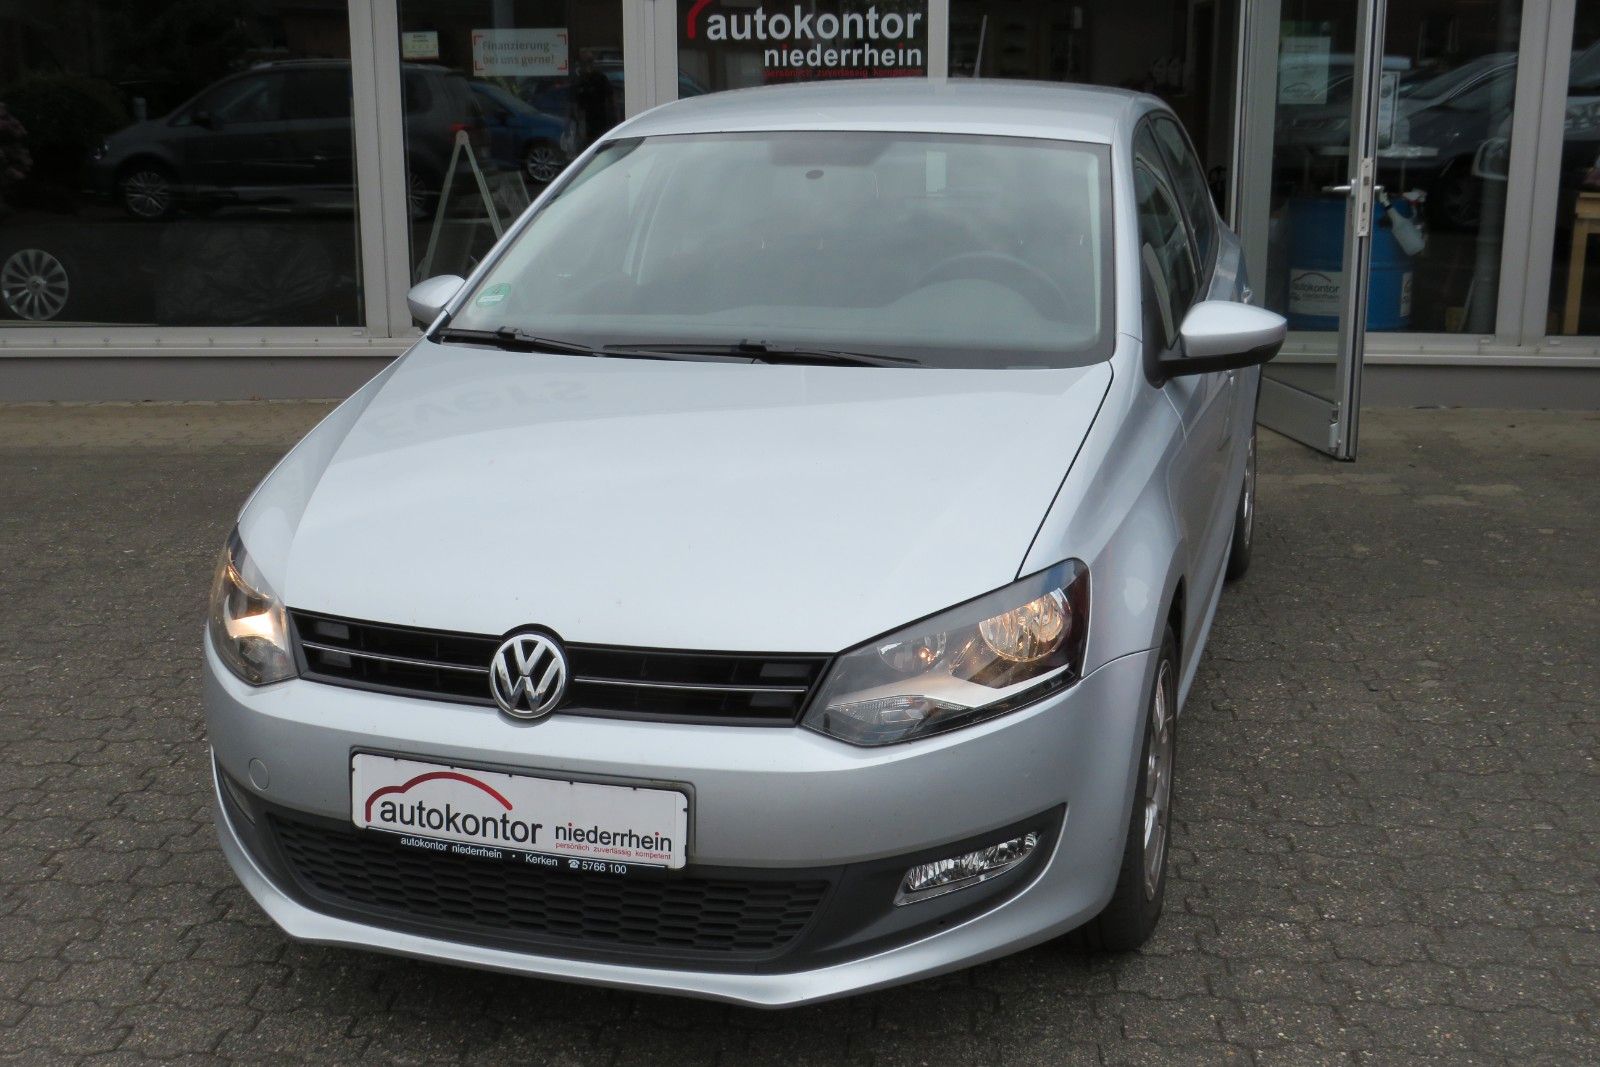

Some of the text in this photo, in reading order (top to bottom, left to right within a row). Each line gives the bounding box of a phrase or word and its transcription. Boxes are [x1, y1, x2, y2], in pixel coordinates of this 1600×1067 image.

[706, 5, 922, 41] autokontor
[482, 40, 550, 54] Finanzierung
[764, 43, 922, 67] niederrhein
[380, 800, 543, 844] autokontor
[555, 822, 672, 852] niederrhein
[400, 836, 627, 875] autokontor niederrhein Kerken 5766 100
[555, 842, 672, 861] persönlich zuverlässig kompetent
